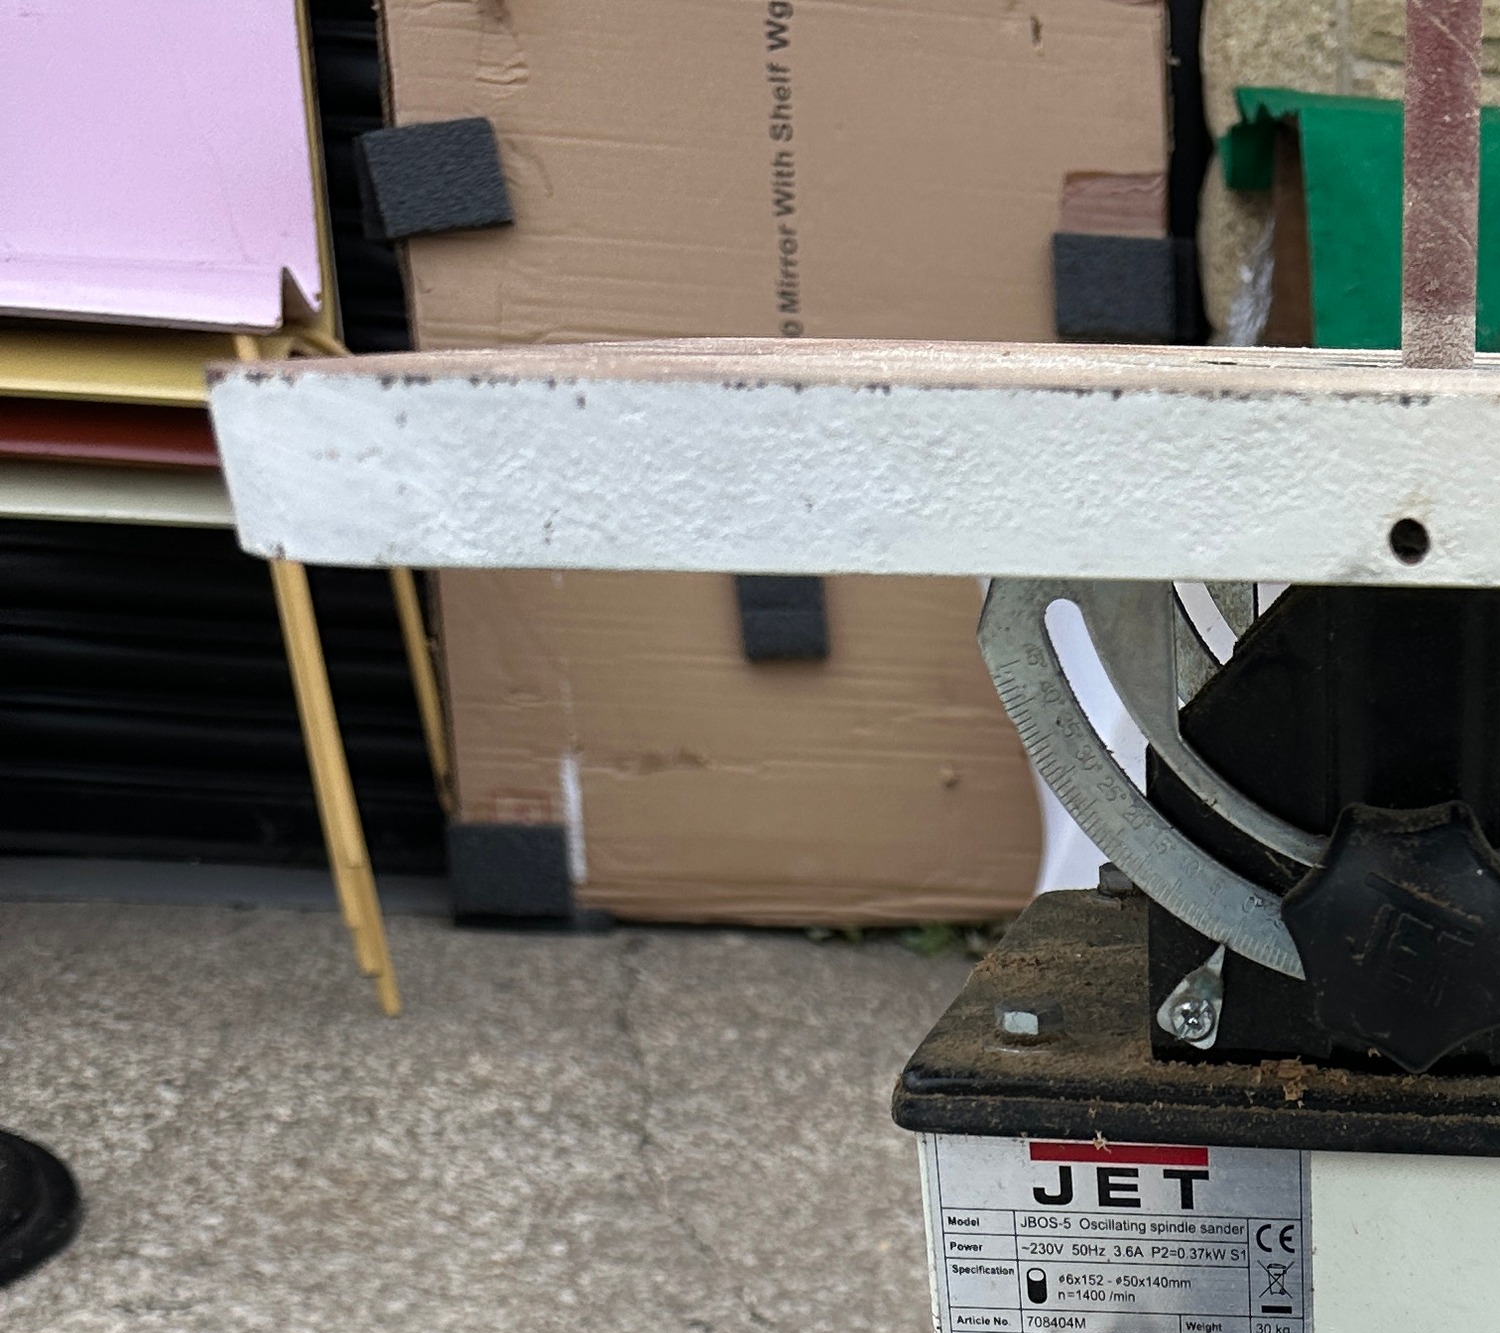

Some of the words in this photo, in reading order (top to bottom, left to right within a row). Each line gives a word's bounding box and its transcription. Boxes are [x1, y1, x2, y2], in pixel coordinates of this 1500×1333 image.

[766, 62, 794, 142] Shelf
[771, 151, 796, 217] With
[776, 224, 800, 313] Mirror
[1033, 1166, 1210, 1210] JET
[947, 1215, 980, 1227] Model
[1020, 1215, 1072, 1230] JBOS-5
[1079, 1217, 1147, 1235] Oscillating
[1150, 1220, 1196, 1236] spindle
[1200, 1222, 1245, 1236] sander
[949, 1241, 983, 1252] Power
[1071, 1244, 1106, 1257] 50Hz
[1113, 1245, 1145, 1258] 3.6A
[1151, 1246, 1227, 1260] P2=0.37kW
[1230, 1249, 1247, 1262] S1
[952, 1264, 1015, 1276] Specification
[1058, 1289, 1106, 1302] n=1400
[1109, 1290, 1136, 1303] /min
[957, 1315, 990, 1326] Article
[994, 1316, 1011, 1326] No.
[1026, 1315, 1086, 1329] 708404M
[1185, 1321, 1223, 1333] Weight
